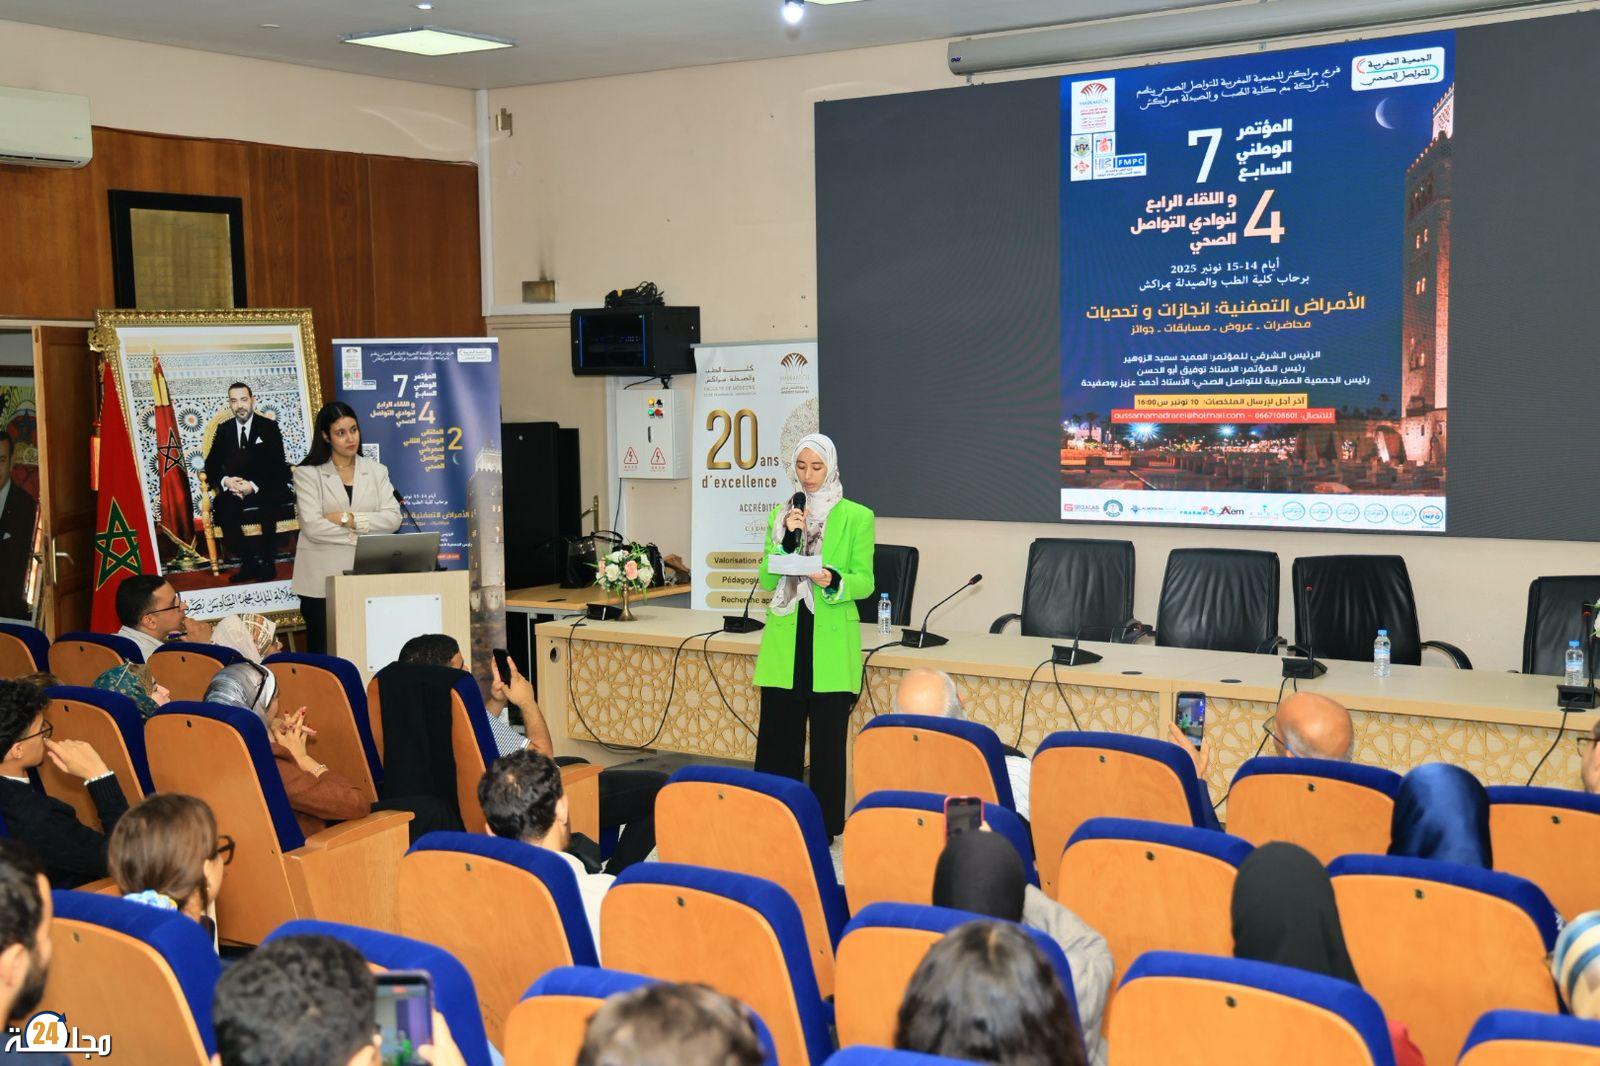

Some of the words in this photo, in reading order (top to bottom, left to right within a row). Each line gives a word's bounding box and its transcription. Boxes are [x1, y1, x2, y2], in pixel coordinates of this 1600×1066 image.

[1367, 57, 1399, 70] المغربية
[1402, 53, 1432, 65] الجمعية
[1280, 67, 1319, 84] مراكش
[1321, 65, 1341, 78] فرع
[1394, 68, 1431, 83] للتواصل
[1235, 118, 1293, 141] المؤتمر
[1187, 127, 1223, 184] 7
[1235, 139, 1292, 164] الوطني
[1118, 157, 1144, 166] FMPC
[1237, 160, 1292, 182] السابع
[1145, 194, 1183, 213] الرابع
[1185, 191, 1224, 206] اللقاء
[1188, 211, 1237, 234] لنوادي
[1243, 189, 1286, 244] 4
[1130, 214, 1186, 234] التواصل
[1189, 232, 1237, 255] الصحي
[1170, 264, 1197, 274] 2025
[1200, 262, 1222, 275] نونبر
[1261, 257, 1280, 273] أيام
[1138, 279, 1172, 292] بمراكش
[1175, 277, 1217, 289] والصيدلة
[1221, 275, 1249, 286] الطب
[1252, 273, 1273, 286] كلية
[1276, 273, 1310, 286] برحاب
[1157, 301, 1210, 318] انجازات
[1295, 291, 1366, 316] الأمراض
[1086, 303, 1138, 320] تحديات
[1130, 323, 1155, 335] جوائز
[1164, 321, 1211, 333] مسابقات
[1219, 320, 1253, 334] عروض
[1263, 319, 1311, 330] محاضرات
[1250, 350, 1286, 363] الشرفي
[1289, 350, 1321, 361] الرئيس
[1136, 366, 1165, 377] الحسن
[1179, 365, 1207, 376] توفيق
[1280, 363, 1306, 374] رئيس
[393, 374, 408, 398] 7
[1139, 377, 1159, 387] أحمد
[1225, 377, 1262, 387] للتواصل
[1264, 376, 1302, 387] المغربية
[1304, 376, 1341, 386] الجمعية
[1343, 376, 1370, 386] رئيس
[418, 401, 436, 424] 4
[447, 427, 463, 450] 2
[706, 408, 759, 471] 20
[760, 455, 780, 467] ans
[739, 502, 780, 512] ACCRÉDITÉ
[714, 556, 757, 564] Valorisation
[722, 575, 760, 584] Pédagogi
